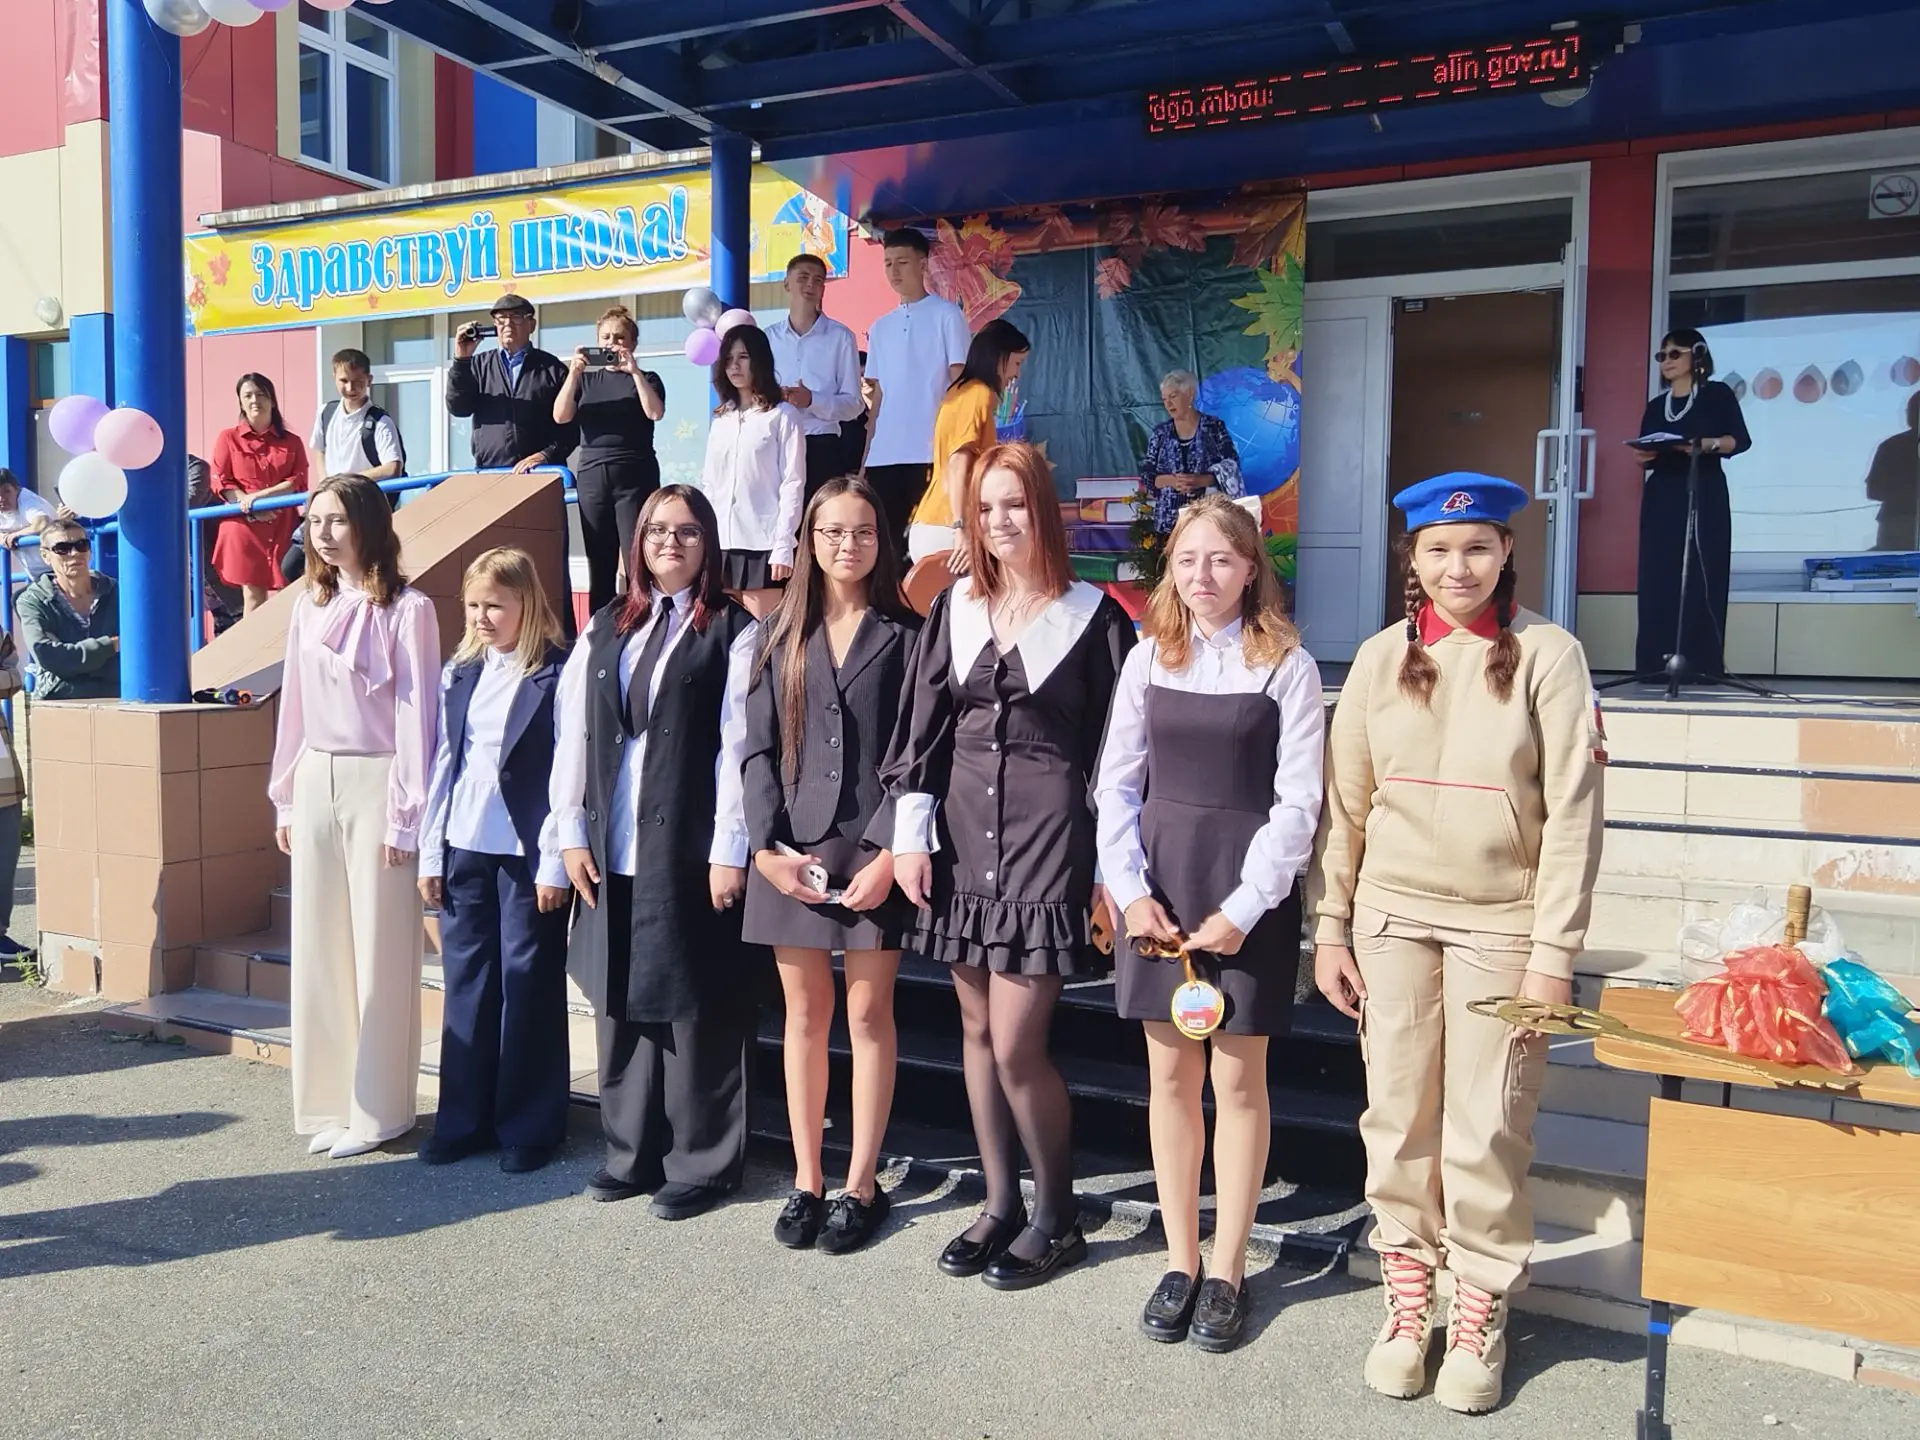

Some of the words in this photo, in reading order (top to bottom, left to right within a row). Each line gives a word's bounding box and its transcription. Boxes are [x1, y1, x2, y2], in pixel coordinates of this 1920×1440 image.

[1433, 47, 1567, 84] alin.gov.ru
[251, 211, 500, 311] Здравствуй
[510, 185, 690, 278] школа!
